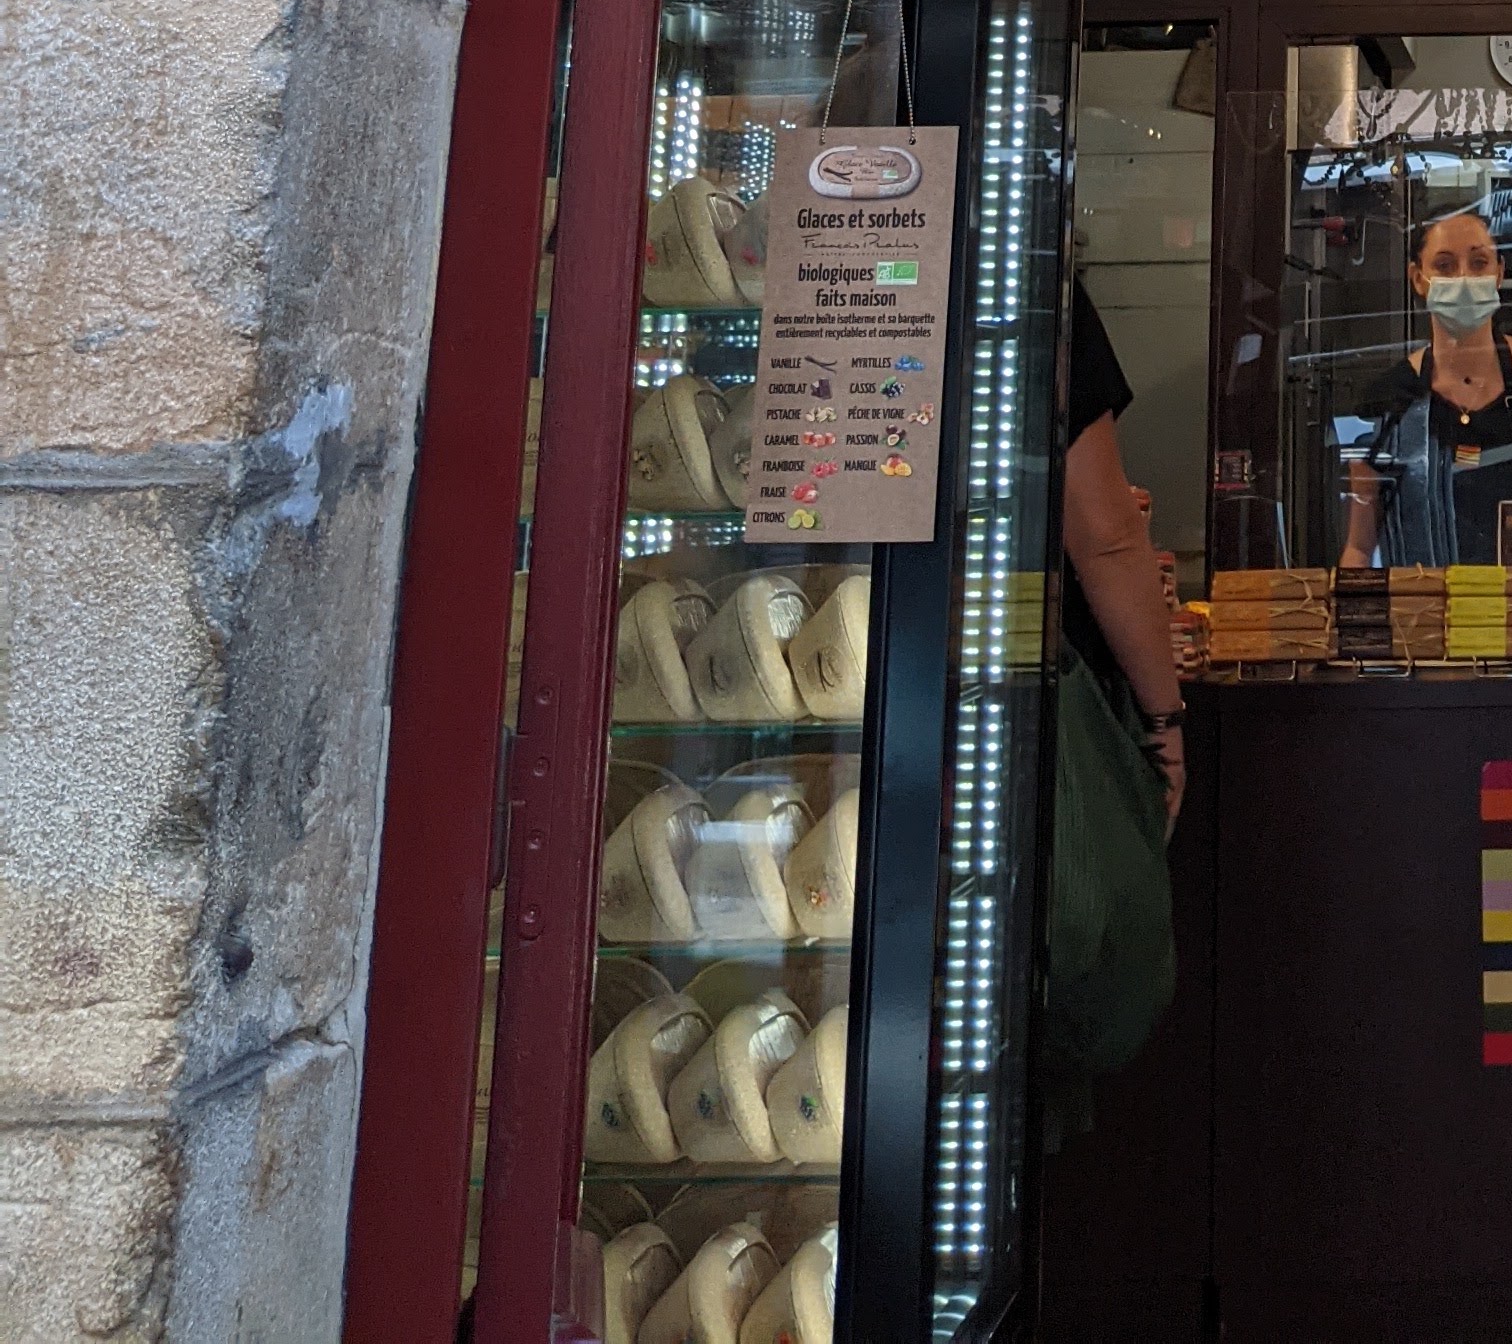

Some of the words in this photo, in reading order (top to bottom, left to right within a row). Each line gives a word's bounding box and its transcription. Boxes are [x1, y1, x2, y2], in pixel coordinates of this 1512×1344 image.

[797, 207, 845, 229] Glaces
[848, 208, 865, 228] et
[868, 206, 927, 229] sorbets
[863, 232, 919, 249] Pralus
[798, 263, 875, 286] biologiques
[815, 288, 847, 307] faits
[850, 288, 896, 307] maison
[774, 313, 792, 325] dans
[794, 314, 815, 325] notre
[816, 313, 836, 324] boîte
[837, 313, 876, 324] isotherme
[877, 313, 886, 324] et
[888, 315, 897, 324] sa
[898, 313, 936, 326] barquette
[776, 327, 823, 339] entièrement
[825, 326, 867, 340] recyclables
[869, 327, 877, 338] et
[878, 326, 932, 340] compostables
[770, 357, 802, 369] VANILLE
[851, 357, 892, 369] MYRTILLES
[768, 383, 808, 395] CHOCOLAT
[850, 382, 876, 394] CASSIS
[766, 409, 801, 420] PISTACHE
[848, 406, 870, 419] PÊCHE
[871, 408, 881, 419] DE
[882, 408, 905, 419] VIGNE
[764, 434, 800, 446] CARAMEL
[846, 434, 879, 446] PASSION
[762, 460, 805, 472] FRAMBOISE
[844, 459, 877, 471] MANGUE
[760, 486, 787, 498] FRAISE
[752, 511, 786, 524] CITRONS
